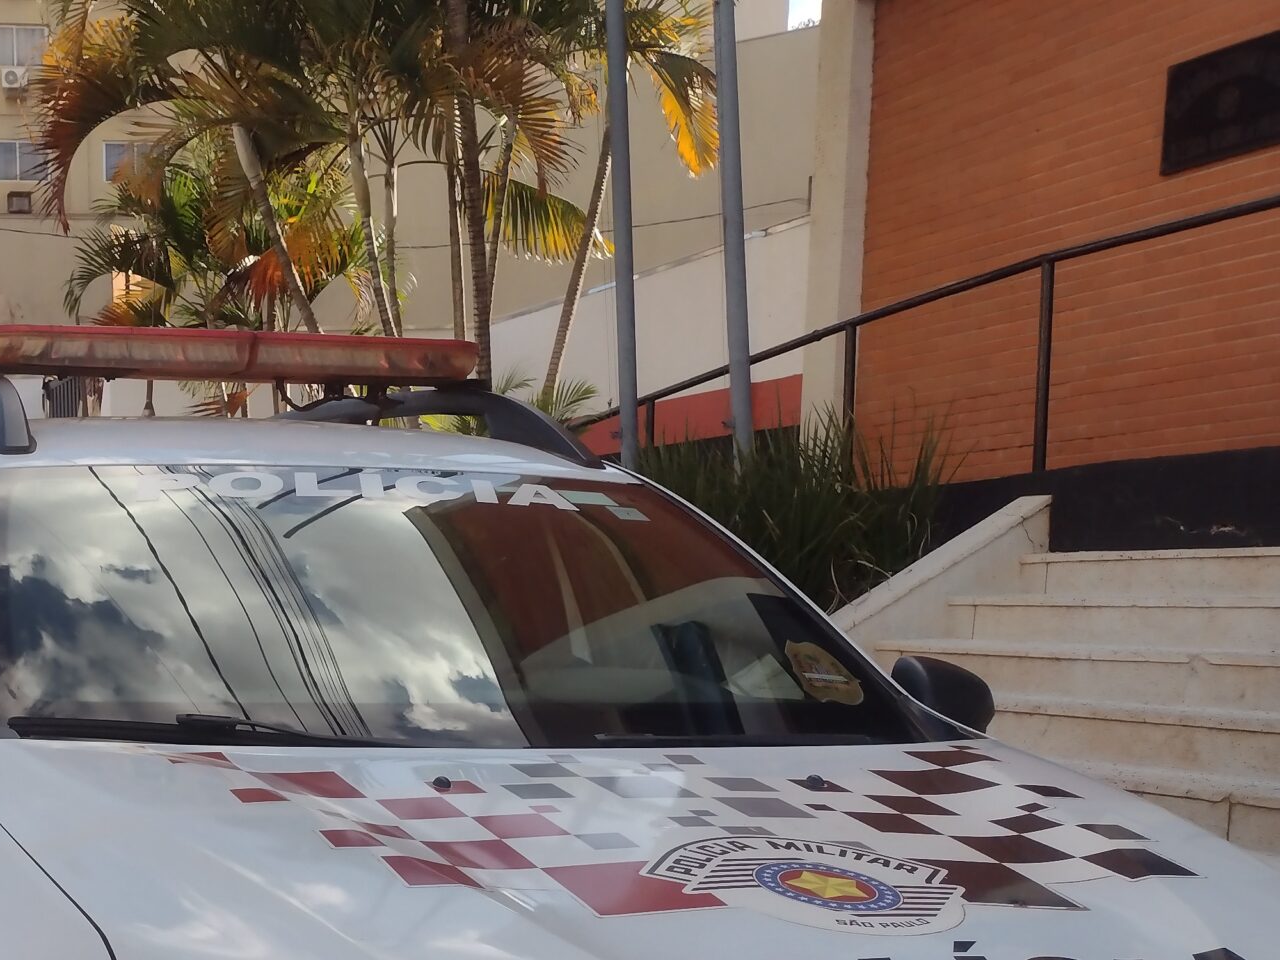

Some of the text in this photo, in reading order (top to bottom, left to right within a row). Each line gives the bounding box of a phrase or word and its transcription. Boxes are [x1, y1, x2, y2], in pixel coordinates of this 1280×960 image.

[665, 840, 918, 877] POLÍCIA MILITAR
[879, 918, 931, 928] PAULO
